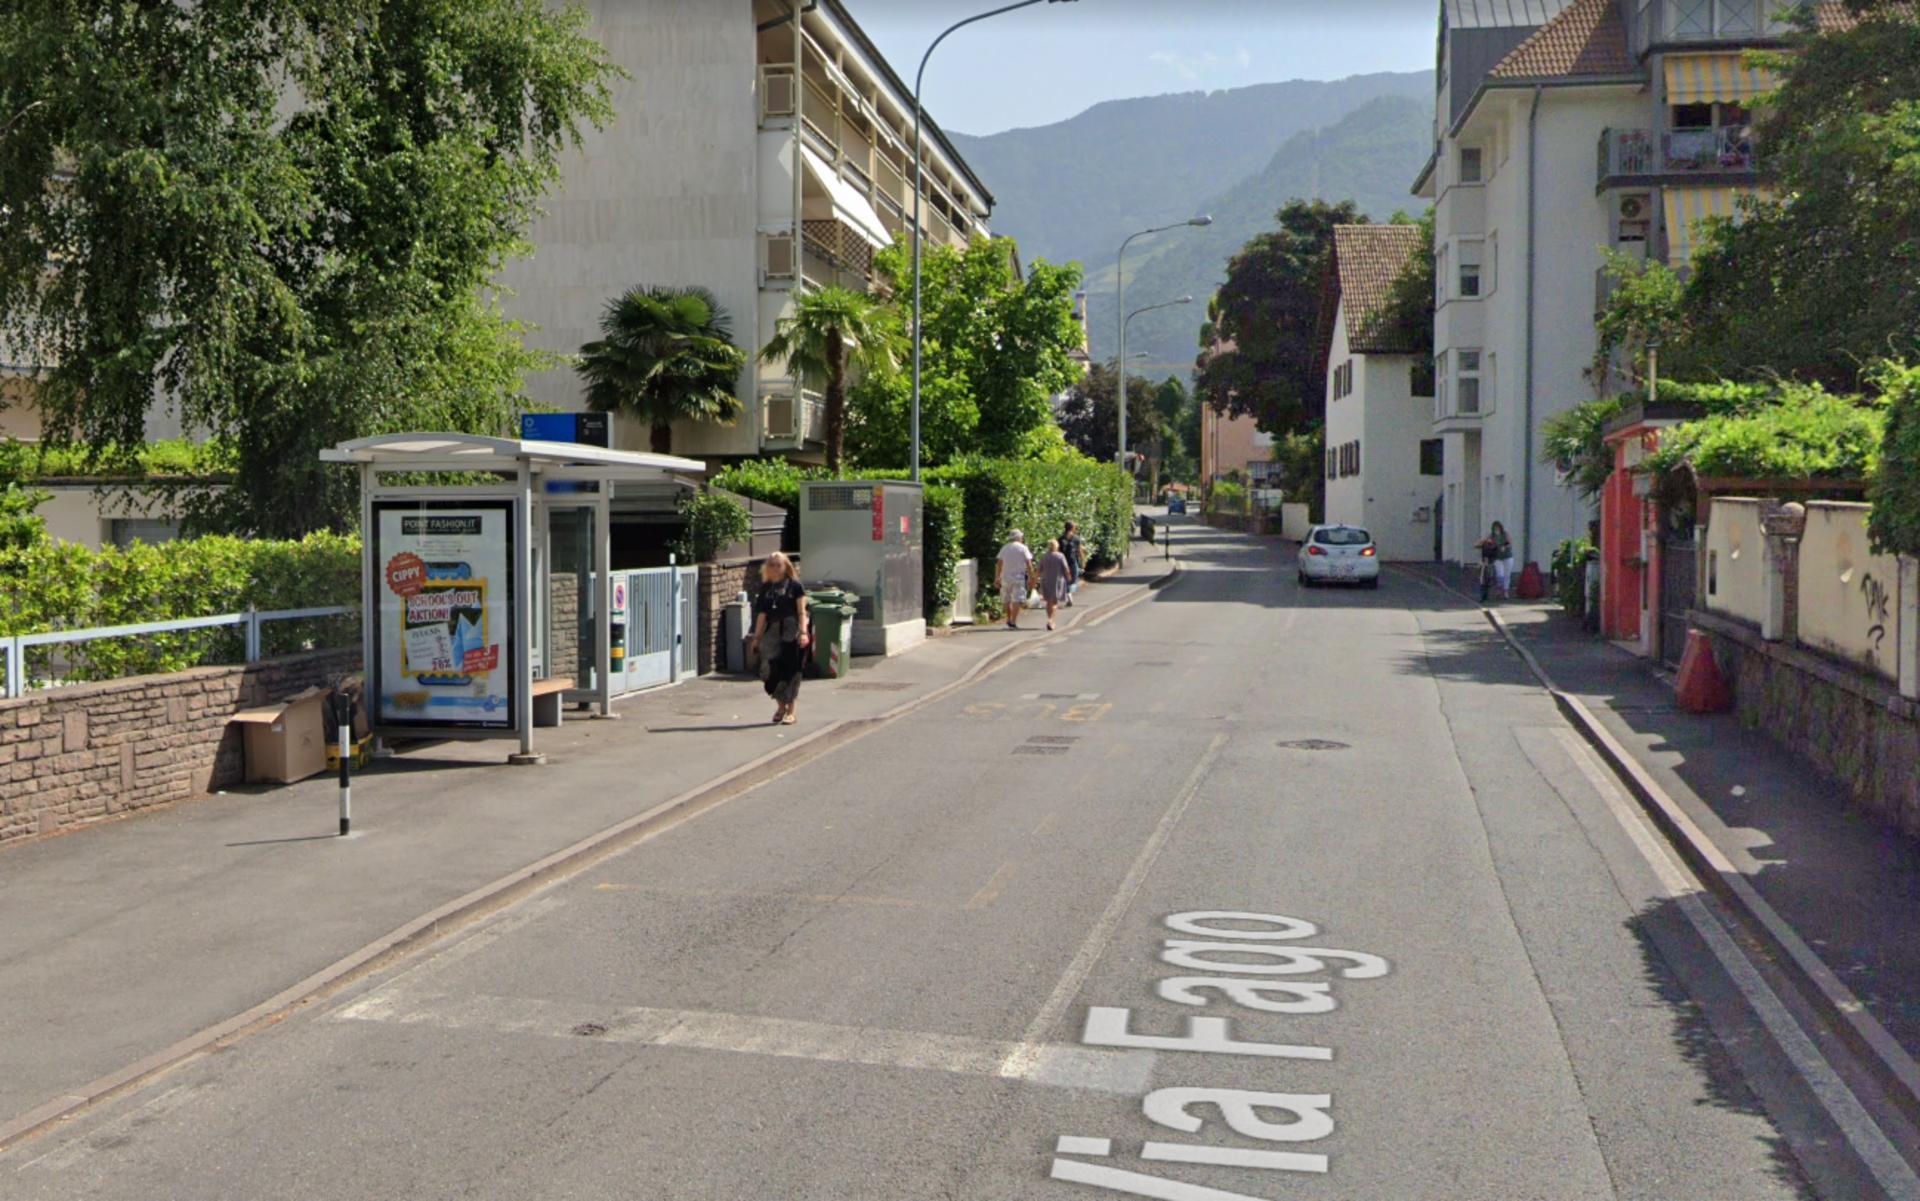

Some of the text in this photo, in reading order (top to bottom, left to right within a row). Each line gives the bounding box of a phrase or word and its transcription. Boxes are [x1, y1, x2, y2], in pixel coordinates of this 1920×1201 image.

[404, 519, 476, 529] POINT FASHION.IT
[392, 566, 420, 583] CIPPY
[456, 591, 477, 604] OUT
[408, 607, 449, 623] AKTION!
